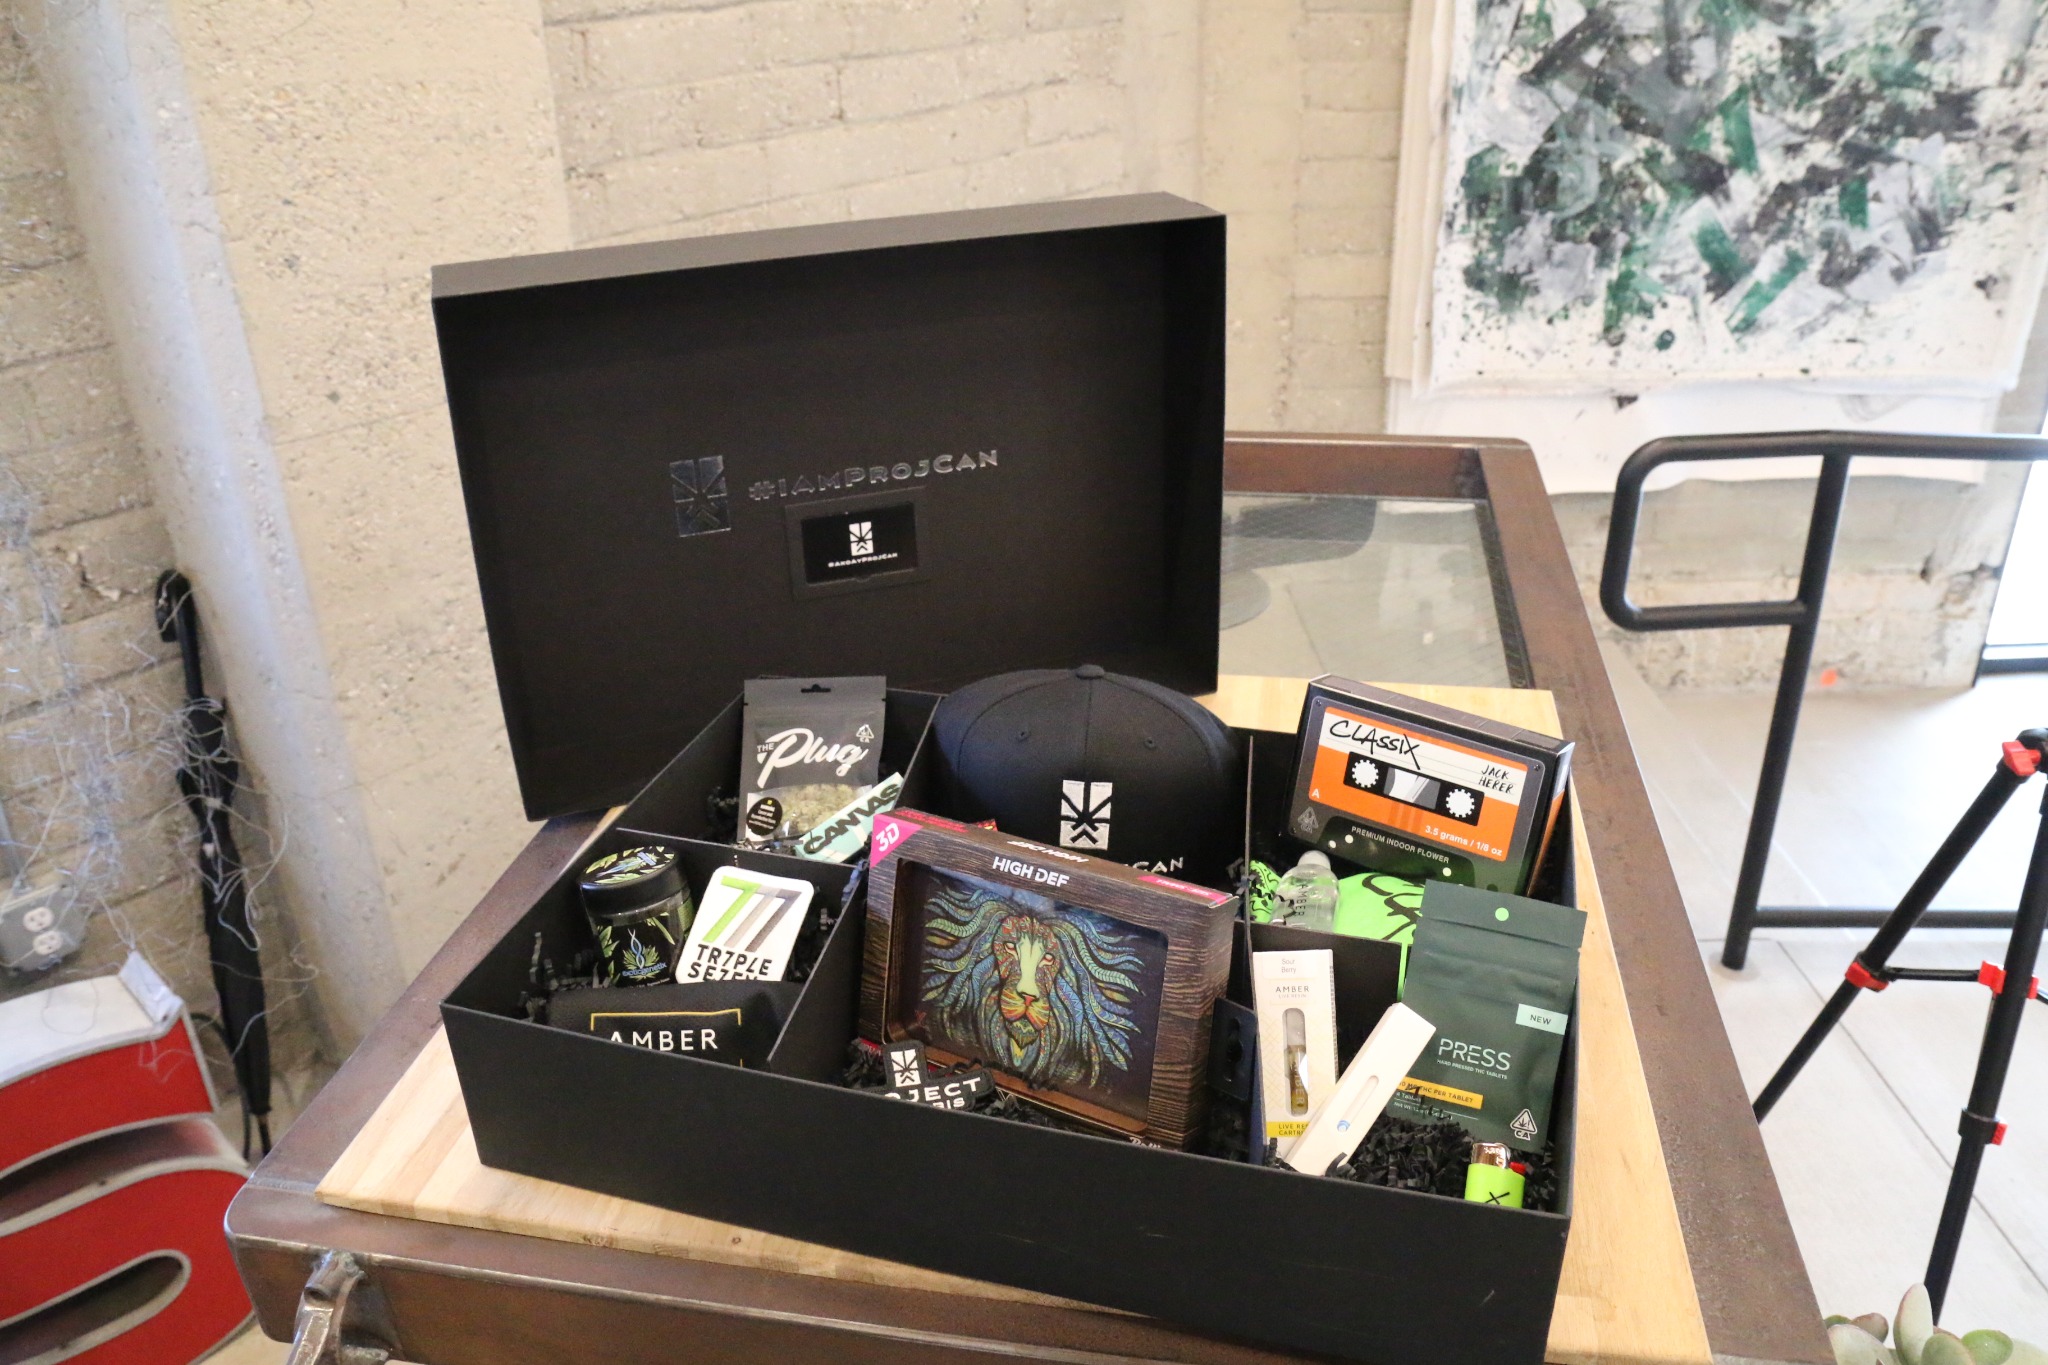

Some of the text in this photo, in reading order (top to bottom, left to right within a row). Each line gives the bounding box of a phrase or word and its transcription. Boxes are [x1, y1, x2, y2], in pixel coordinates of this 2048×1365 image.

[750, 450, 998, 500] #IAMPROJCAN
[757, 728, 869, 789] THE Plug
[1329, 720, 1420, 771] CLASSIX
[1478, 776, 1515, 794] HERER
[1481, 764, 1511, 780] JACK
[1311, 788, 1320, 799] A
[876, 822, 900, 852] 3D
[1351, 825, 1450, 864] PREMIUM INDOOR FLOWER
[1425, 825, 1439, 837] 3.5
[1440, 830, 1468, 846] grams
[1476, 840, 1489, 852] 1/8
[1491, 847, 1503, 857] oz
[992, 856, 1071, 888] HIGH DEF
[1275, 985, 1310, 993] AMBER
[1530, 1013, 1552, 1026] NEW
[610, 1028, 719, 1052] AMBER
[1438, 1037, 1512, 1072] PRESS
[1433, 1089, 1447, 1097] PER
[1448, 1092, 1474, 1103] TABLET
[1515, 1130, 1529, 1139] CA
